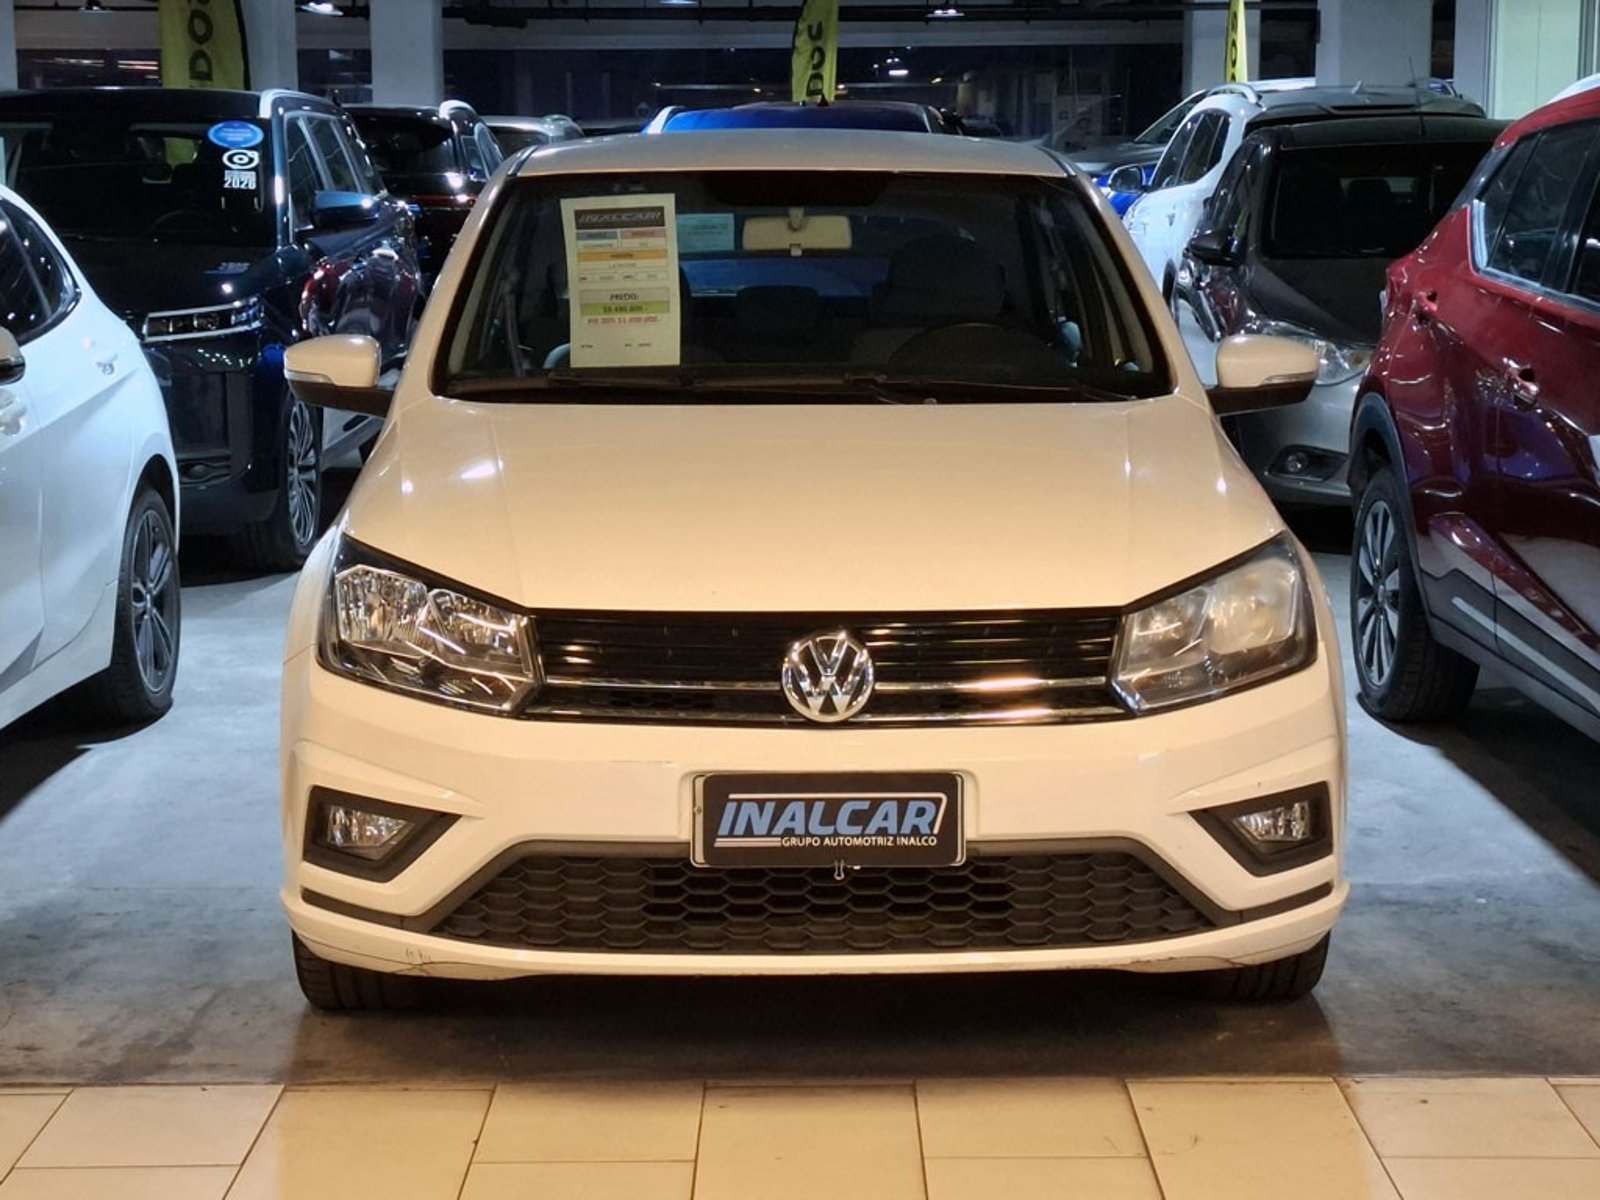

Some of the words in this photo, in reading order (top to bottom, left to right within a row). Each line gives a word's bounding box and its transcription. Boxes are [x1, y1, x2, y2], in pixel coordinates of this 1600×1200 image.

[188, 0, 213, 82] DO
[717, 800, 937, 836] INALCAR
[782, 836, 820, 847] GRUPO
[823, 836, 894, 847] AUTOMOTRIZ
[897, 836, 937, 847] INALCO
